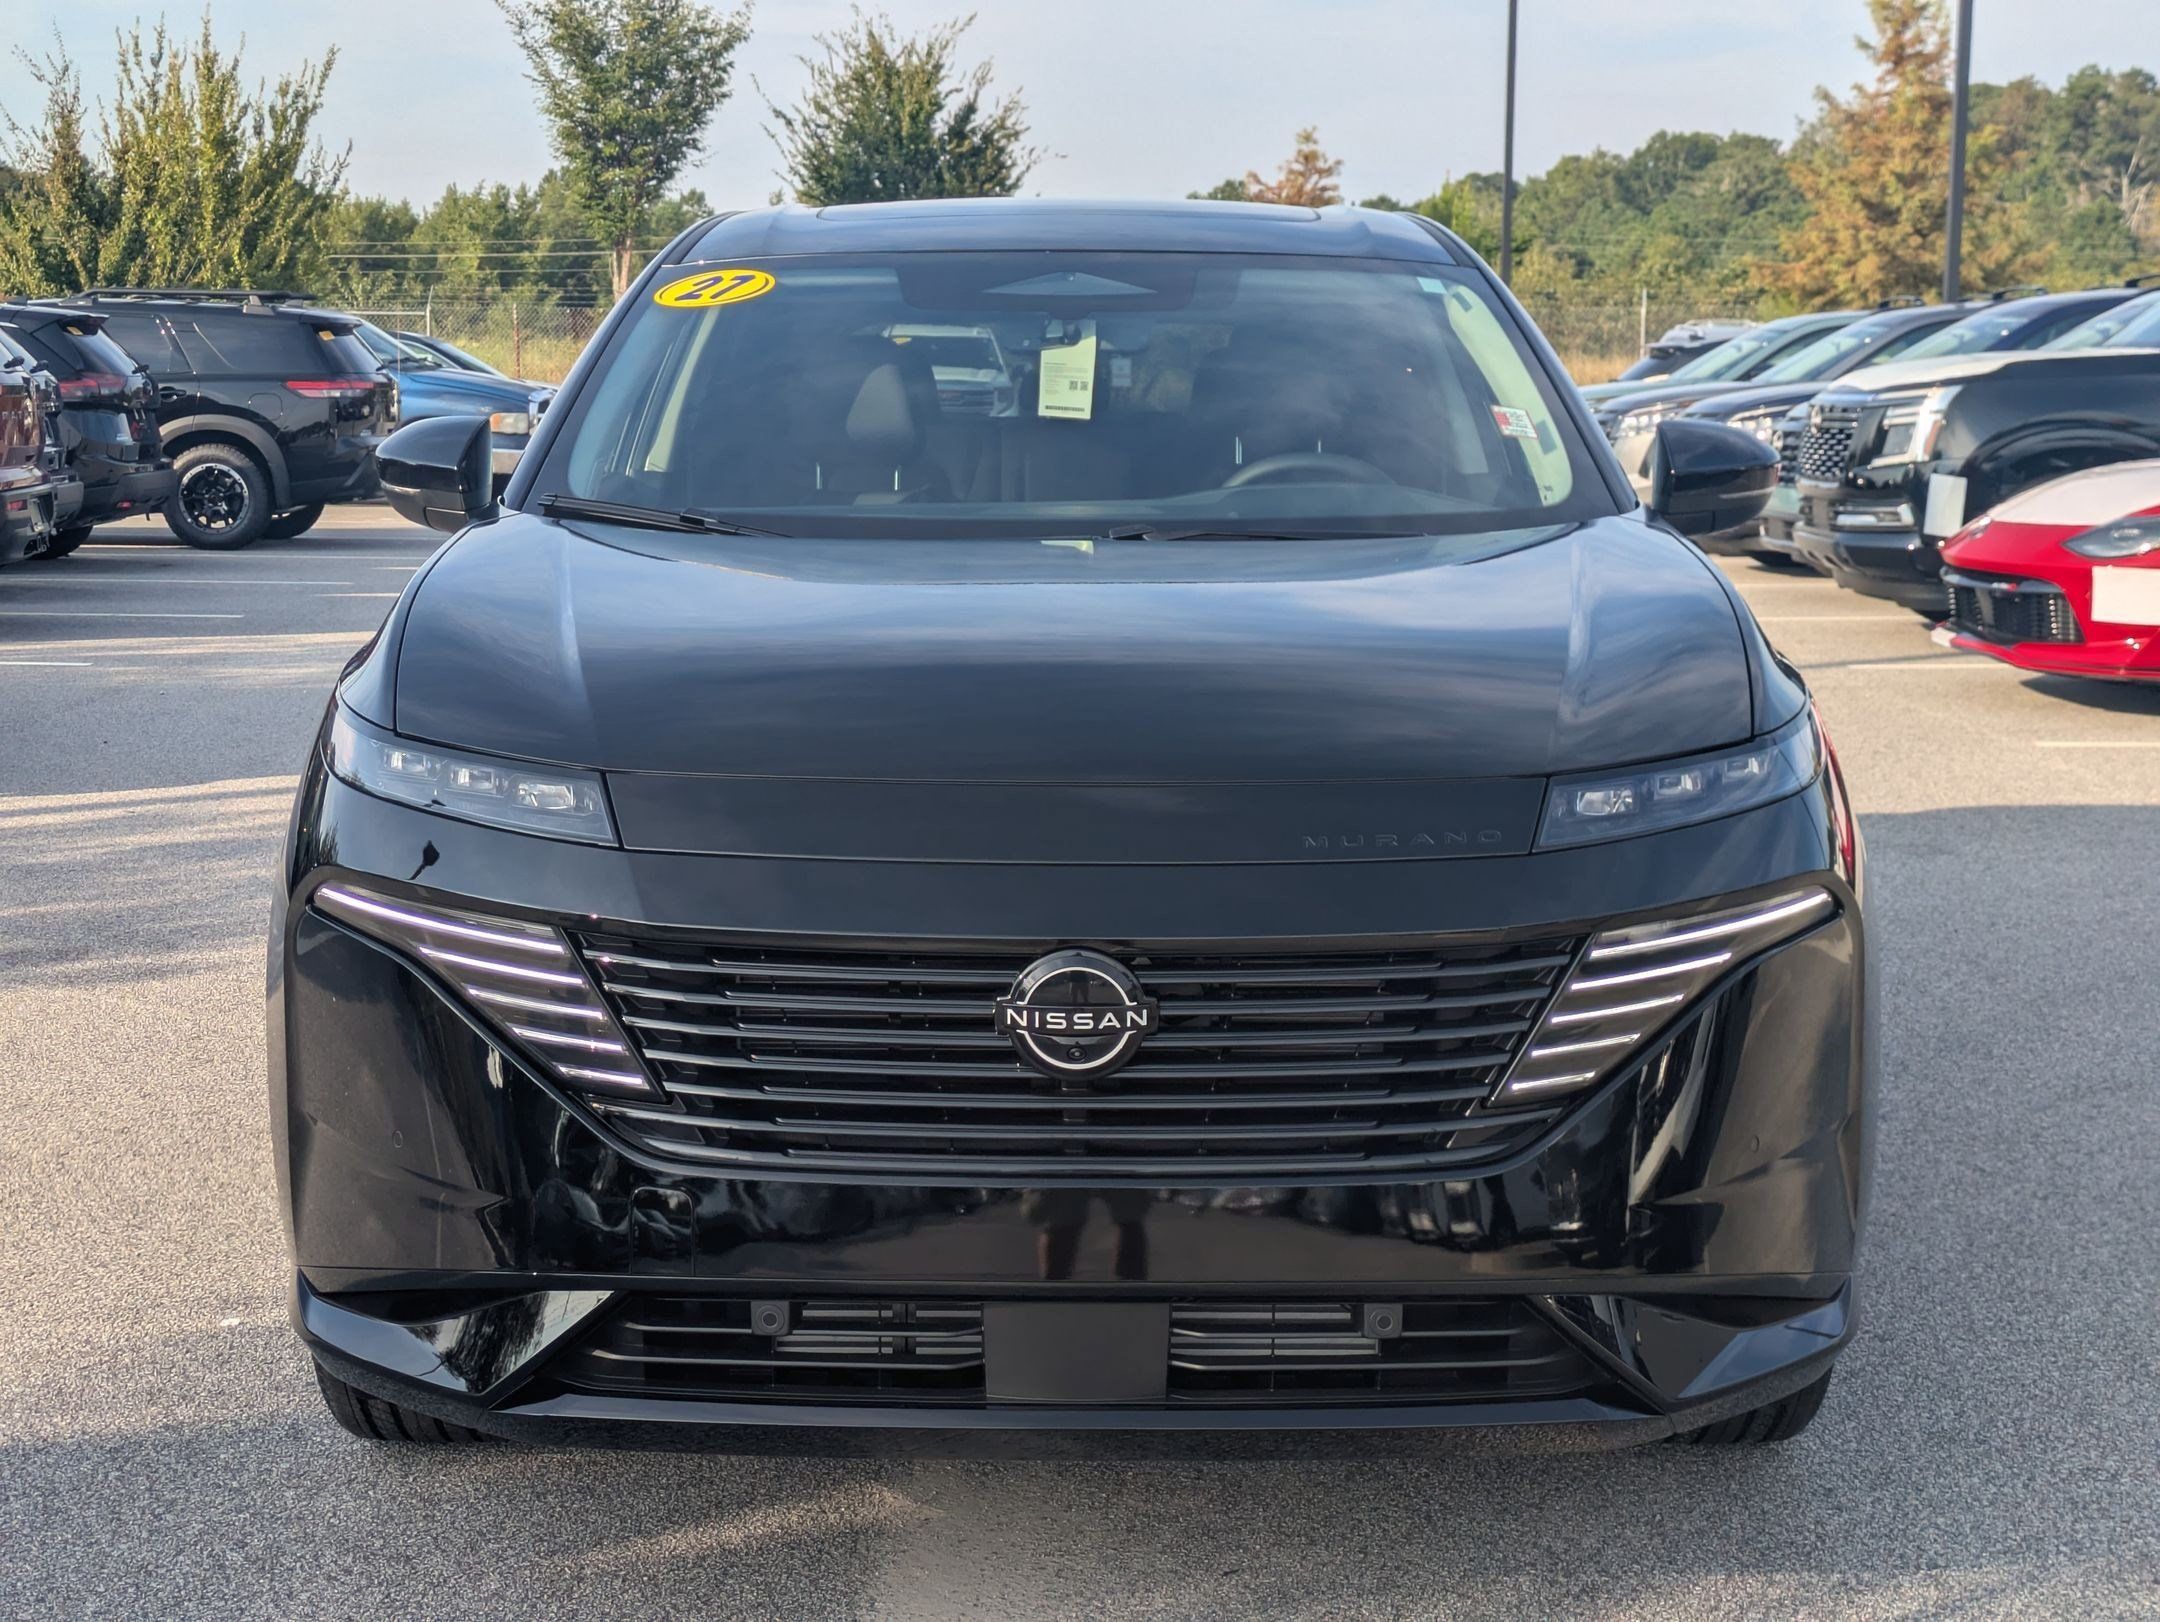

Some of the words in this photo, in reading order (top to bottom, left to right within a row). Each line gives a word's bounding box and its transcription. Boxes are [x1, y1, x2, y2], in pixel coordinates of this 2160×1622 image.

[674, 274, 756, 301] 27
[1302, 829, 1502, 849] MURANO
[1006, 1008, 1148, 1030] NISSAN
